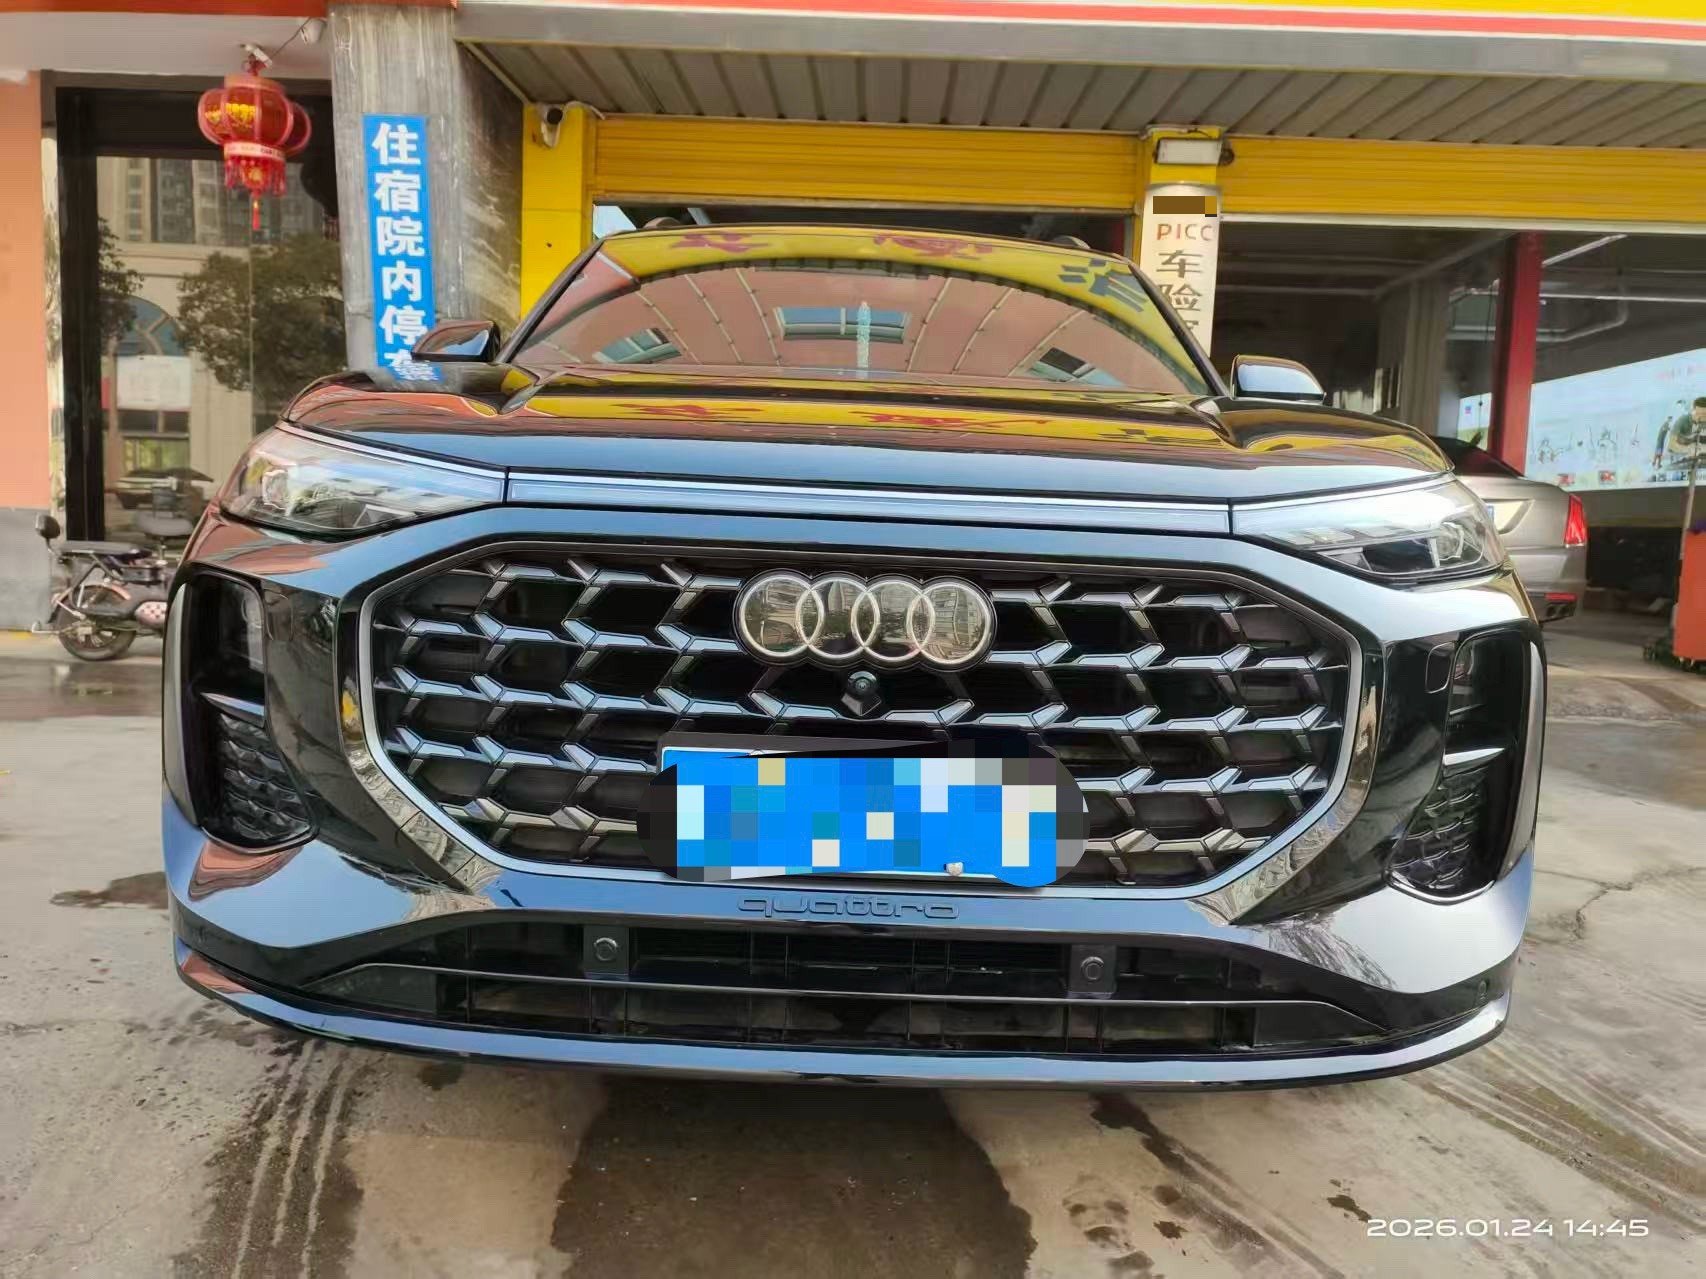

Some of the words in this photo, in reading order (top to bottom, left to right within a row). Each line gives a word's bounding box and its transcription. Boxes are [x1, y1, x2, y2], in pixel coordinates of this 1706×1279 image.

[1156, 223, 1213, 241] PICC
[1156, 249, 1204, 331] 车险
[738, 896, 959, 919] quattro
